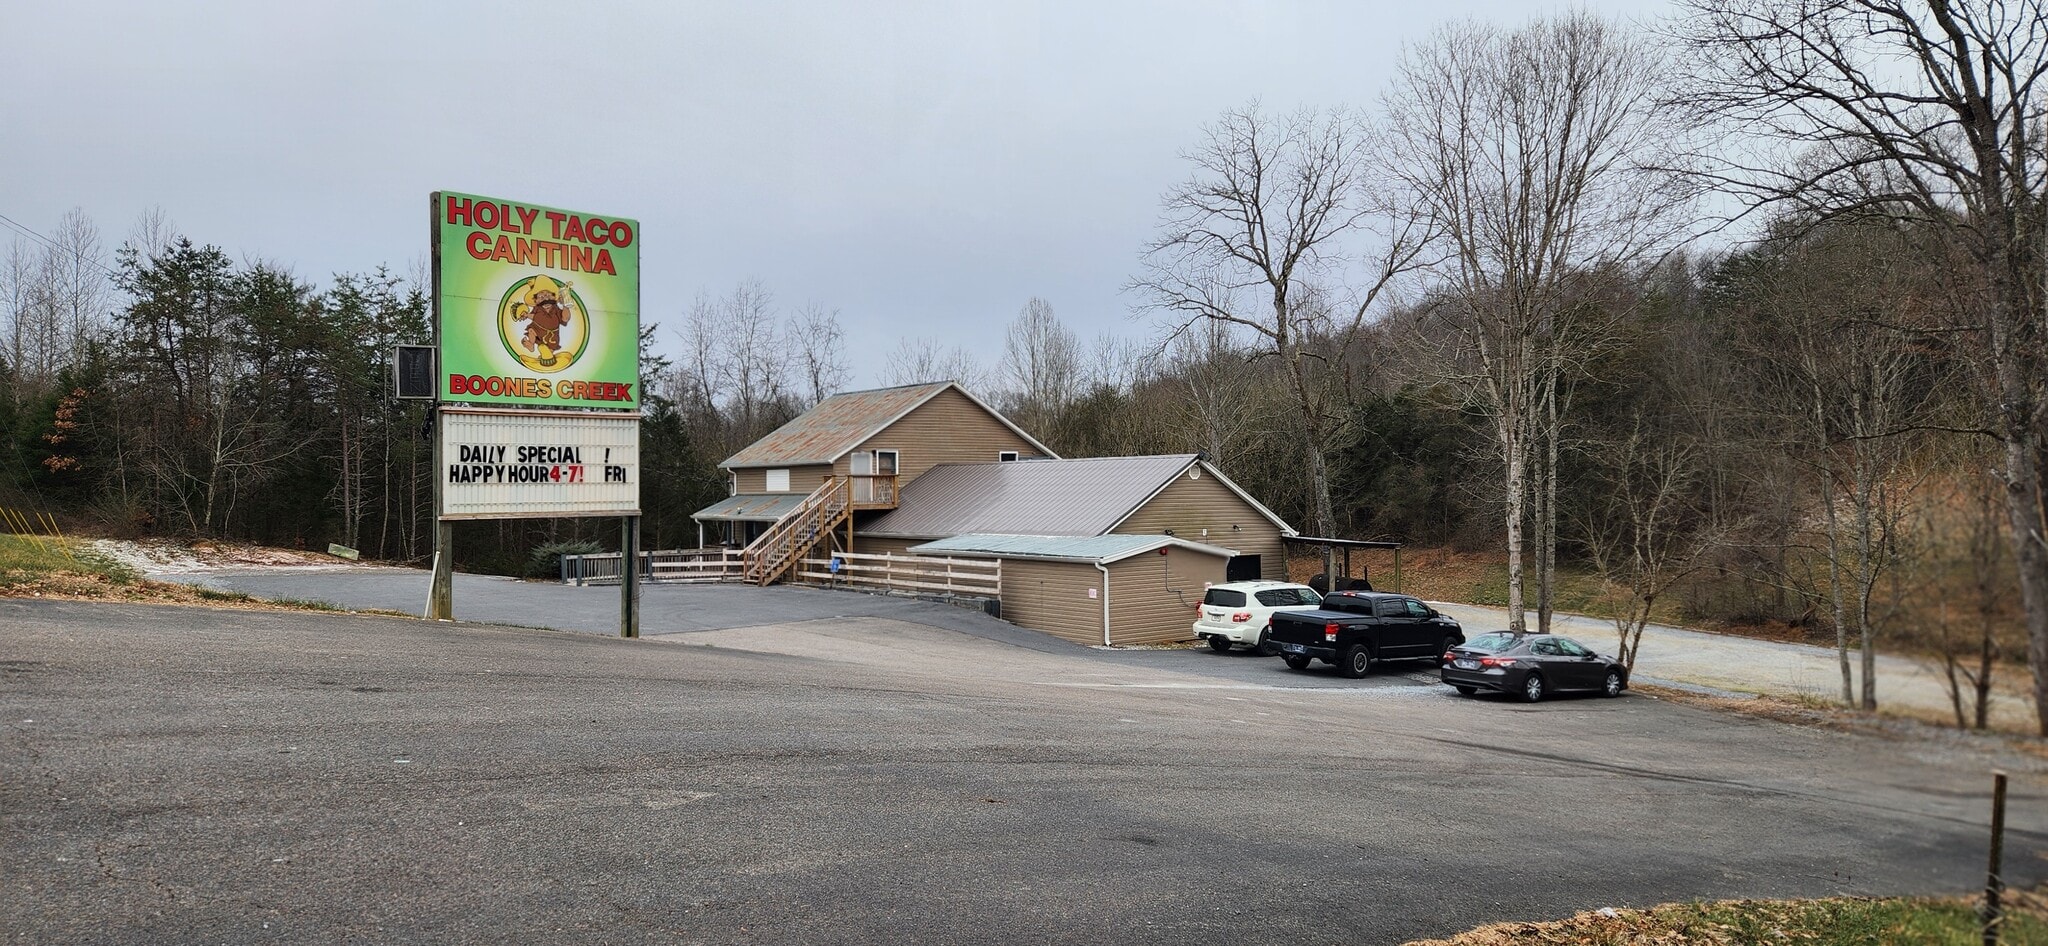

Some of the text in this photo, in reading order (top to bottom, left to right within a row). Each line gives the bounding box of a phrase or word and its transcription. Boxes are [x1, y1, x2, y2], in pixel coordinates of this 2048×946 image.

[447, 196, 633, 248] HOLY TACO
[466, 231, 617, 275] CANTINA
[450, 374, 633, 402] BOONES CREEK
[460, 445, 506, 464] DAILY
[518, 445, 582, 463] SPECIAL
[449, 464, 505, 483] HAPPY
[604, 466, 626, 483] FRI
